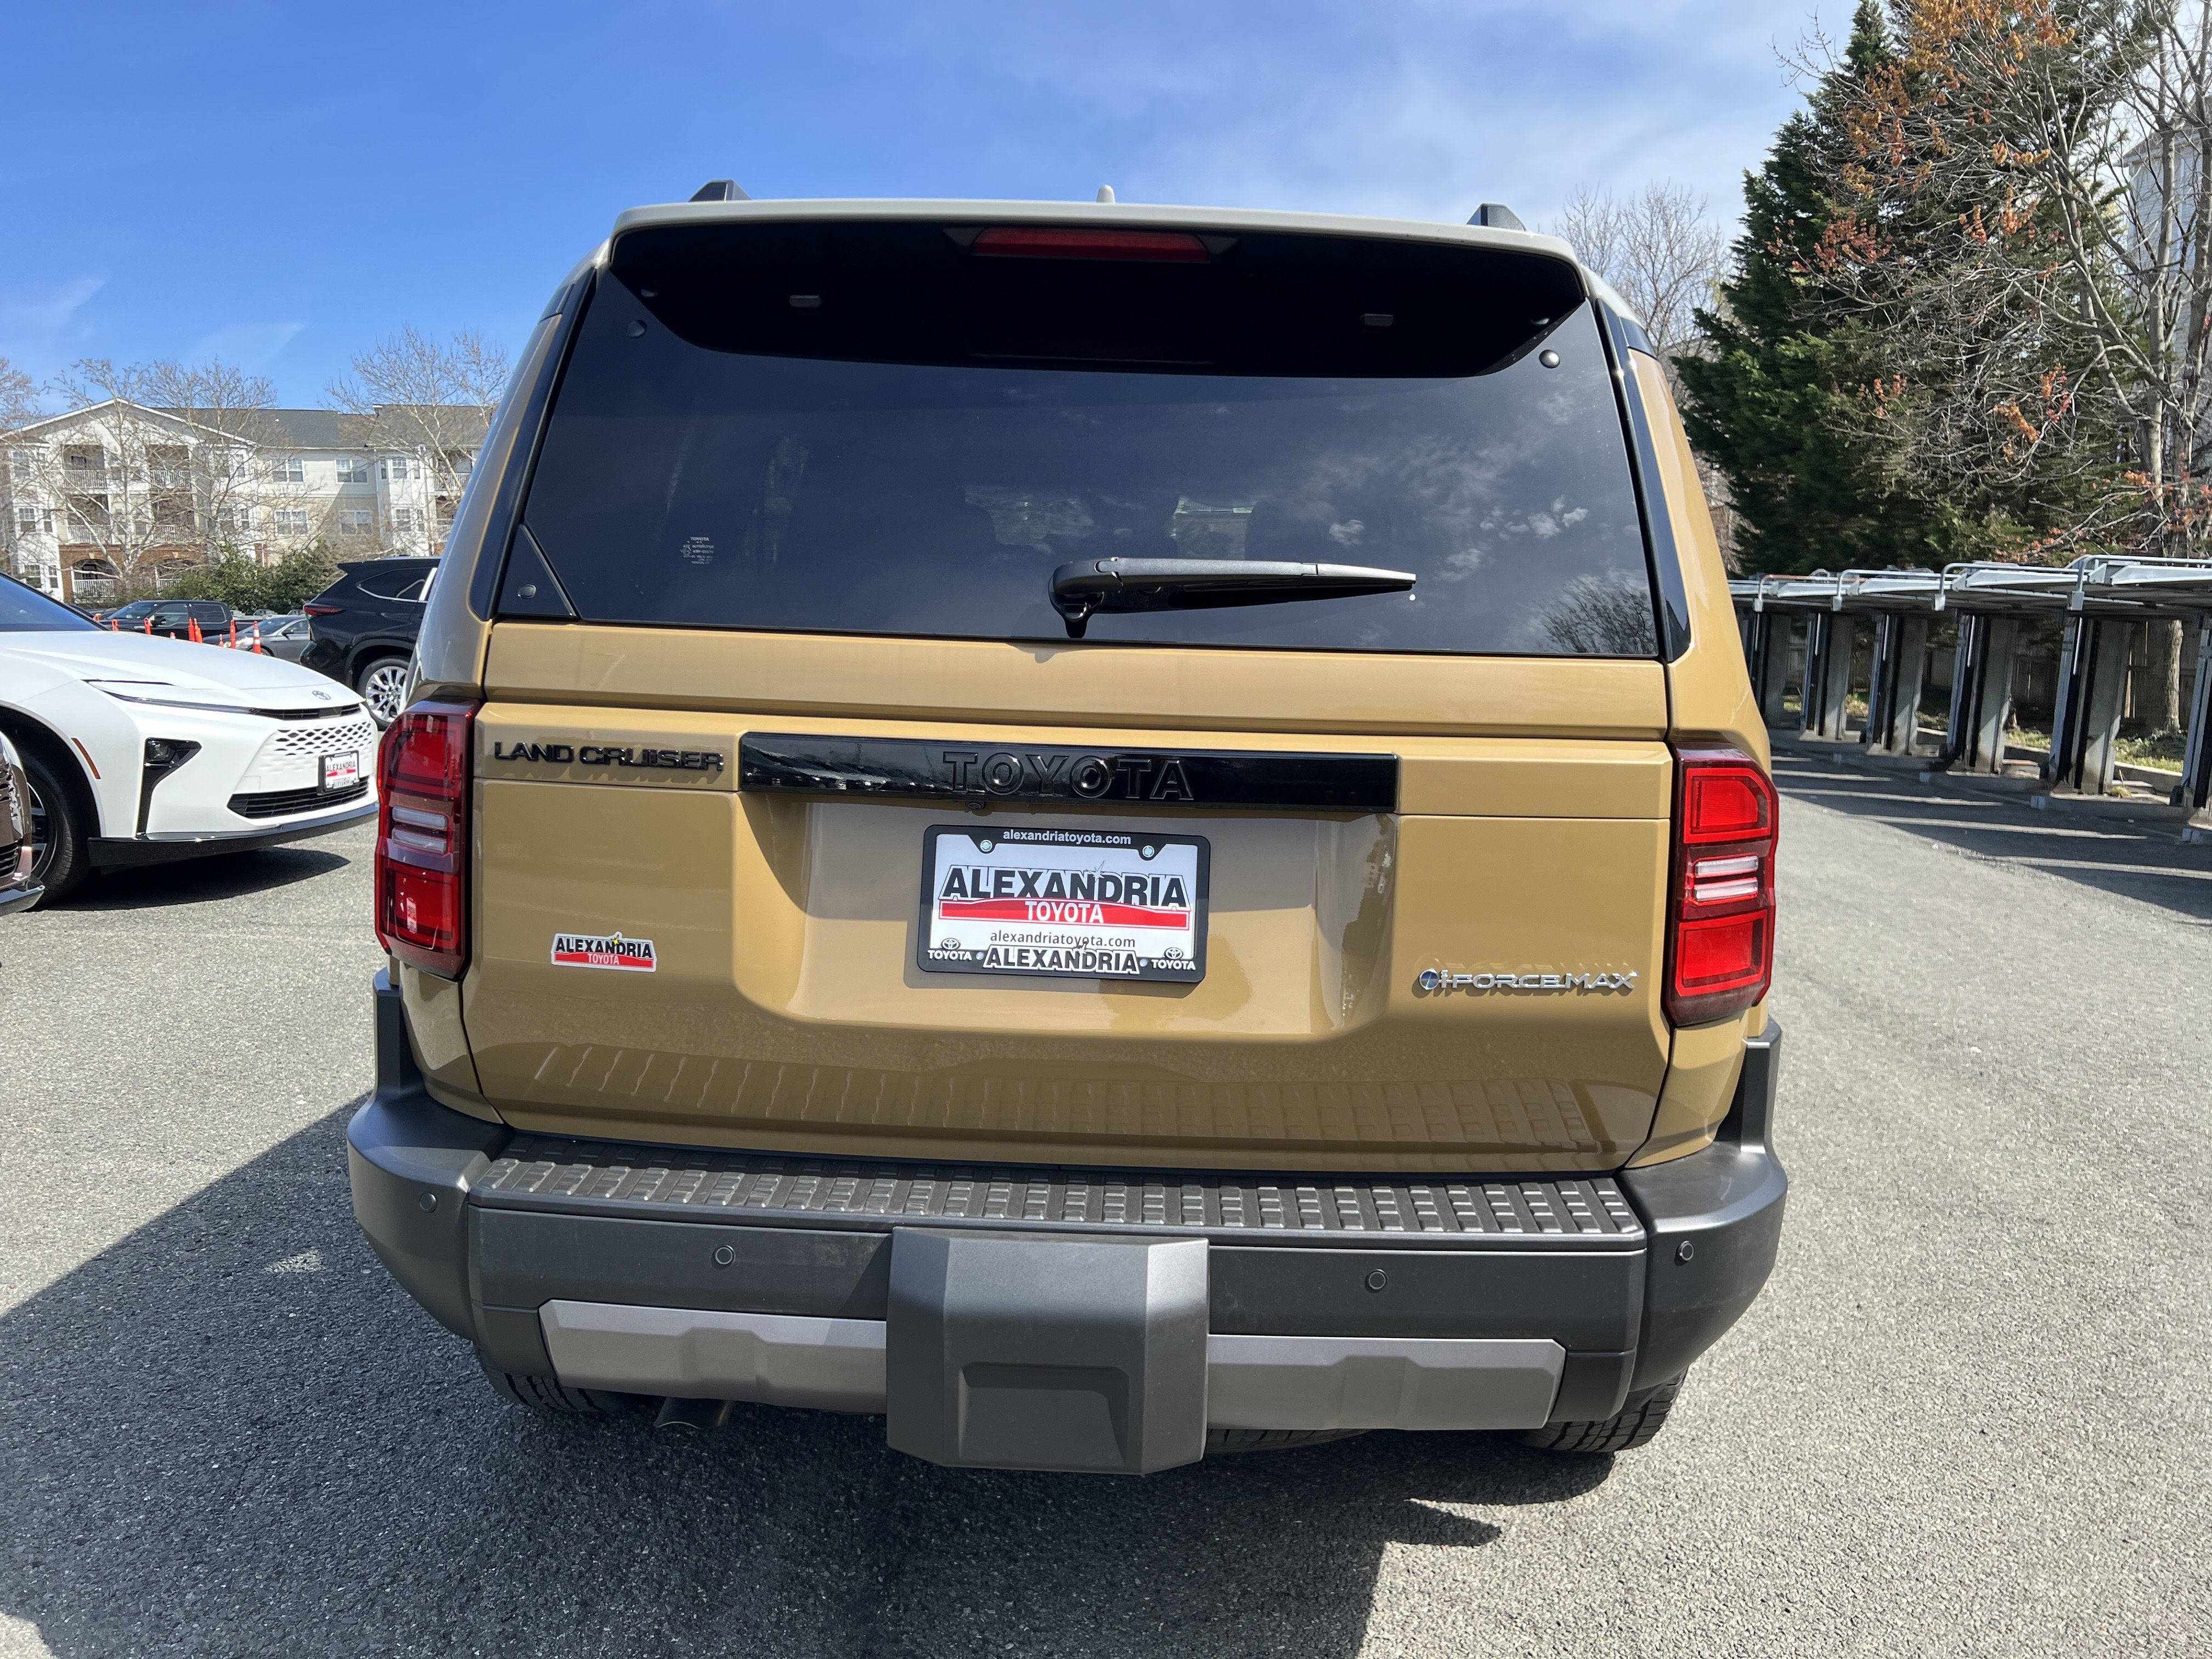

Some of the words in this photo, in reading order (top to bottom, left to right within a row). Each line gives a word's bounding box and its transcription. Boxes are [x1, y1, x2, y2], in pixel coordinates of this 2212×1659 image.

[494, 741, 574, 764] LAND
[579, 745, 724, 771] CRUISER
[326, 760, 356, 772] ALEXANDRIA
[942, 751, 1195, 800] TOYOTA
[1003, 829, 1132, 845] alexandriatoyota.com
[941, 867, 1188, 909] ALEXANDRIA
[1024, 900, 1104, 924] TOYOTA
[555, 937, 652, 958] ALEXANDRIA
[990, 930, 1136, 948] alexandriatoyota.com
[587, 953, 620, 965] TOYOTA
[927, 950, 972, 960] TOYOTA
[985, 947, 1137, 972] ALEXANDRIA
[1151, 959, 1196, 970] TOYOTA
